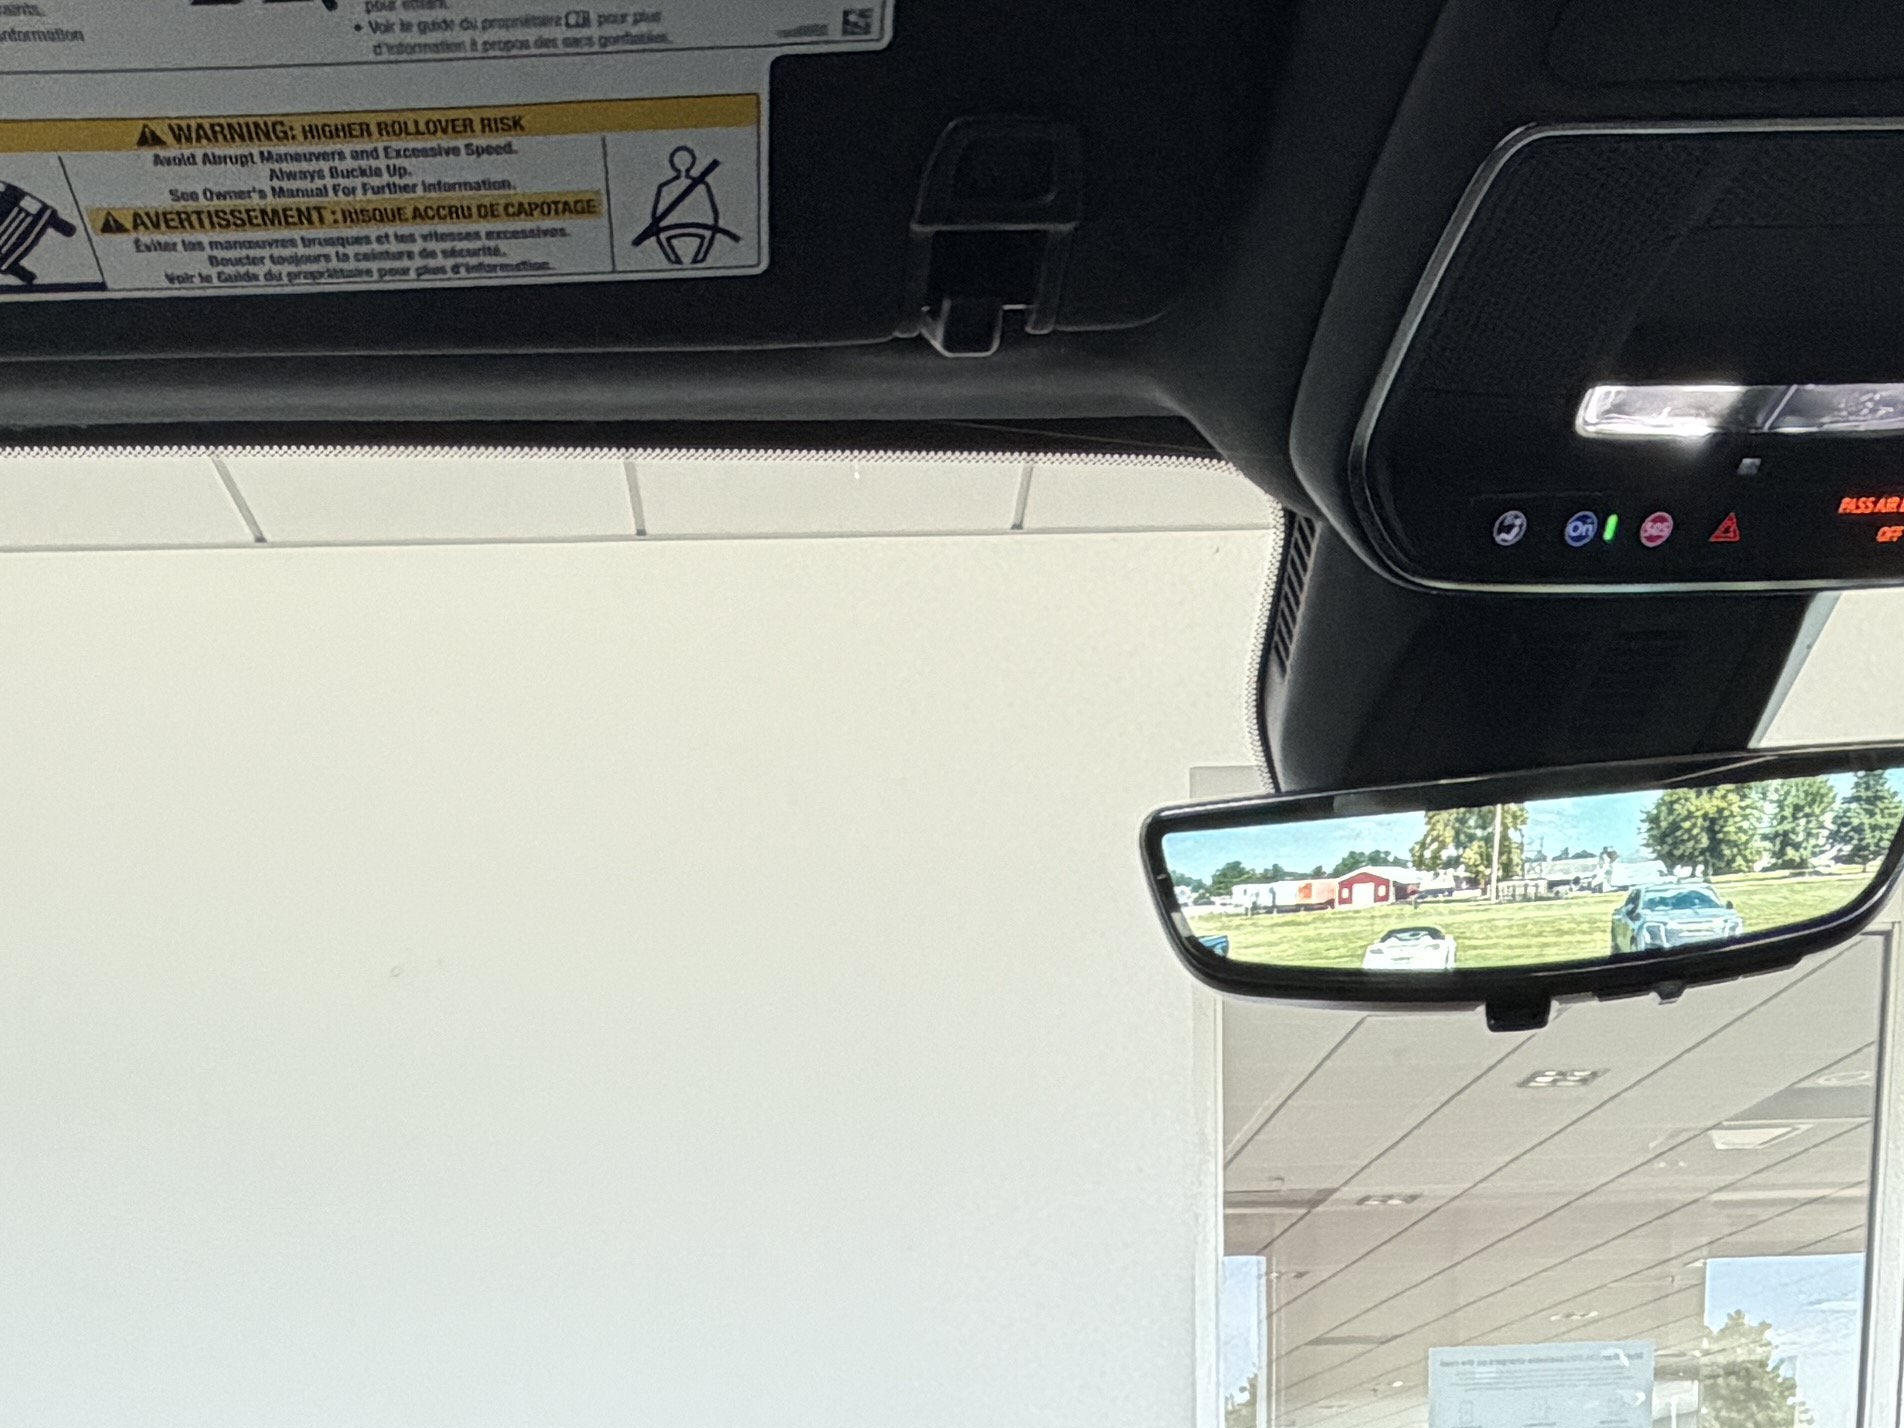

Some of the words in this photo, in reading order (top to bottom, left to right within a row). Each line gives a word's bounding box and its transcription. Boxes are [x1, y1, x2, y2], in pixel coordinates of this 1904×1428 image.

[168, 120, 296, 145] WARNING:
[301, 122, 371, 140] HIGHER
[377, 119, 475, 137] ROLLOVER
[480, 115, 525, 133] RISK
[152, 151, 197, 167] Avoid
[201, 149, 257, 166] Abrupt
[261, 148, 346, 164] Maneuvers
[350, 146, 380, 161] and
[383, 143, 461, 159] Excessive
[464, 141, 518, 157] Speed.
[268, 167, 326, 182] Always
[329, 165, 383, 179] Buckle
[386, 164, 412, 180] Up.
[169, 188, 200, 202] See
[203, 186, 267, 201] Owner's
[271, 184, 329, 199] Manual
[333, 183, 357, 197] For
[361, 180, 418, 196] Further
[342, 207, 409, 225] RISQUE
[413, 205, 473, 222] ACCRU
[477, 203, 500, 219] DE
[504, 199, 597, 217] CAPOTAGE
[1838, 497, 1875, 514] PASS
[1876, 525, 1904, 542] OFF
